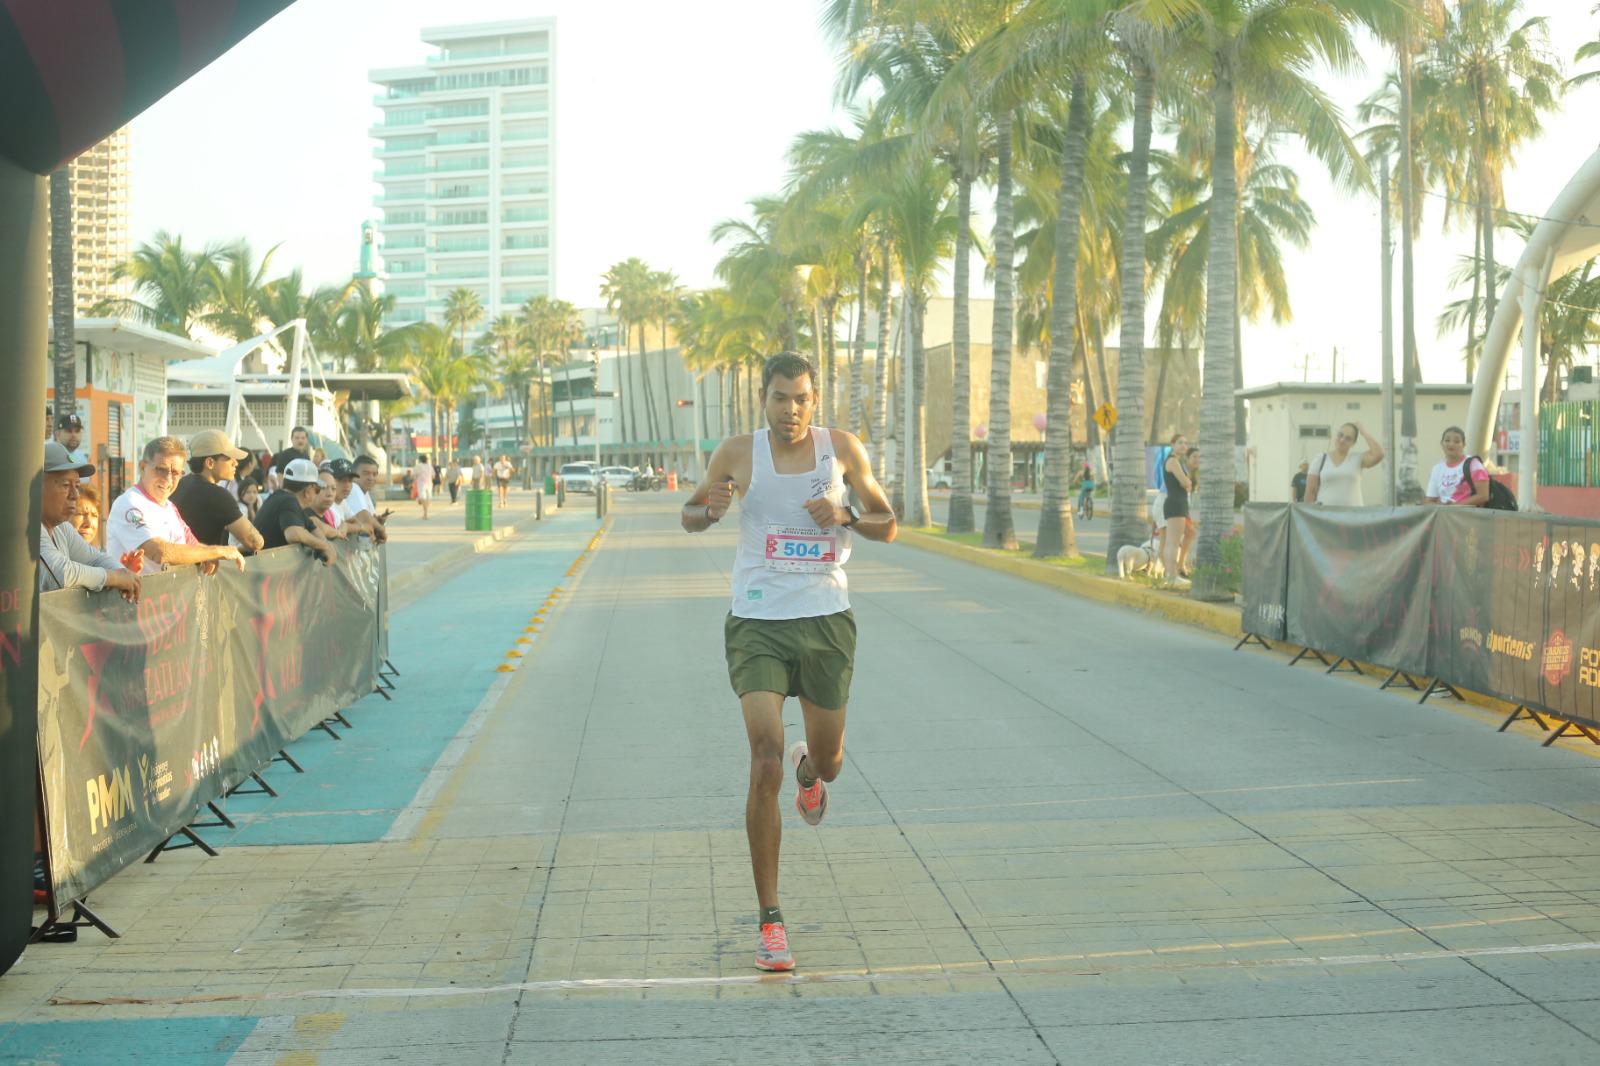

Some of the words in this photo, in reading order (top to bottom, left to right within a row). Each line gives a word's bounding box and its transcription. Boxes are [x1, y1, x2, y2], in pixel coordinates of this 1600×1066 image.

[784, 542, 820, 557] 504
[1580, 647, 1600, 668] PO
[86, 764, 135, 835] PMM
